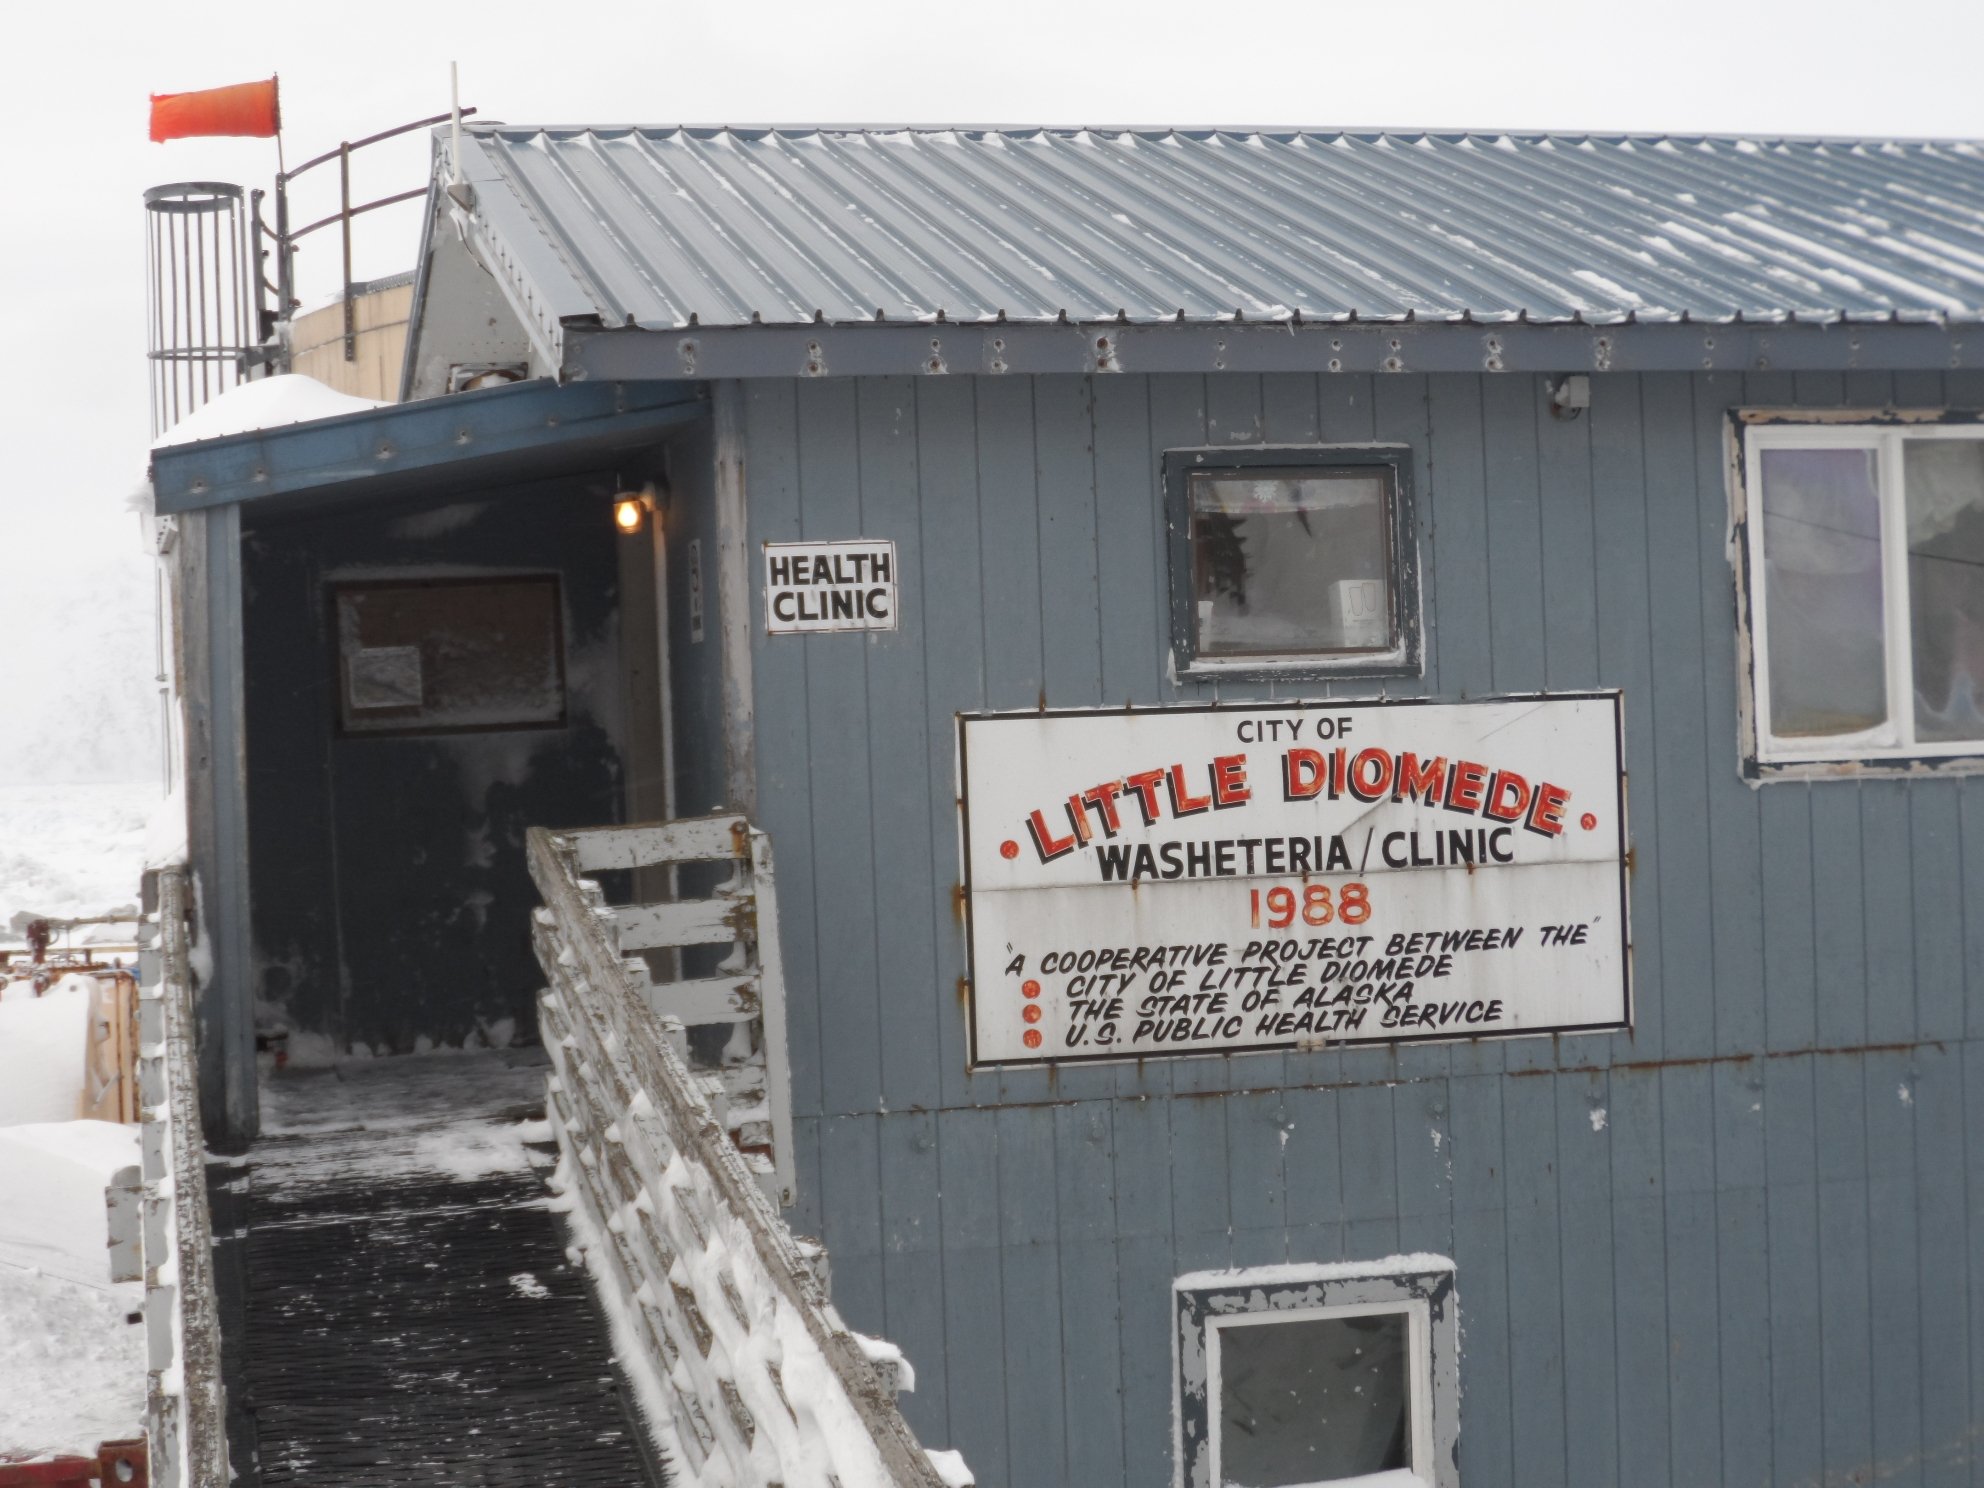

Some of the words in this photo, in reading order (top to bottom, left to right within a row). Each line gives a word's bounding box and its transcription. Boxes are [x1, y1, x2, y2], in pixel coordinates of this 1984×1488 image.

[770, 553, 890, 586] HEALTH
[773, 588, 888, 622] CLINIC
[1237, 719, 1303, 743] CITY
[1316, 717, 1353, 740] OF
[1025, 754, 1251, 865] LITTLE
[1281, 747, 1571, 838] DIOMEDE
[1250, 882, 1371, 929] 1988
[1040, 943, 1228, 975] COOPERATIVE
[1241, 935, 1374, 965] PROJECT
[1385, 927, 1523, 956] BETWEEN
[1066, 973, 1136, 999] CITY
[1150, 969, 1186, 994] OF
[1198, 964, 1307, 992] LITTLE
[1320, 954, 1453, 983] DIOMEDE
[1065, 1022, 1122, 1047] U.S.
[1132, 1016, 1243, 1044] PUBLIC
[1255, 1008, 1367, 1036] HEALTH
[1380, 1000, 1503, 1029] SERVICE
[1069, 998, 1123, 1021] THE
[1136, 992, 1228, 1018] STATE
[1241, 989, 1280, 1012] OF
[1293, 981, 1413, 1009] ALASKA
